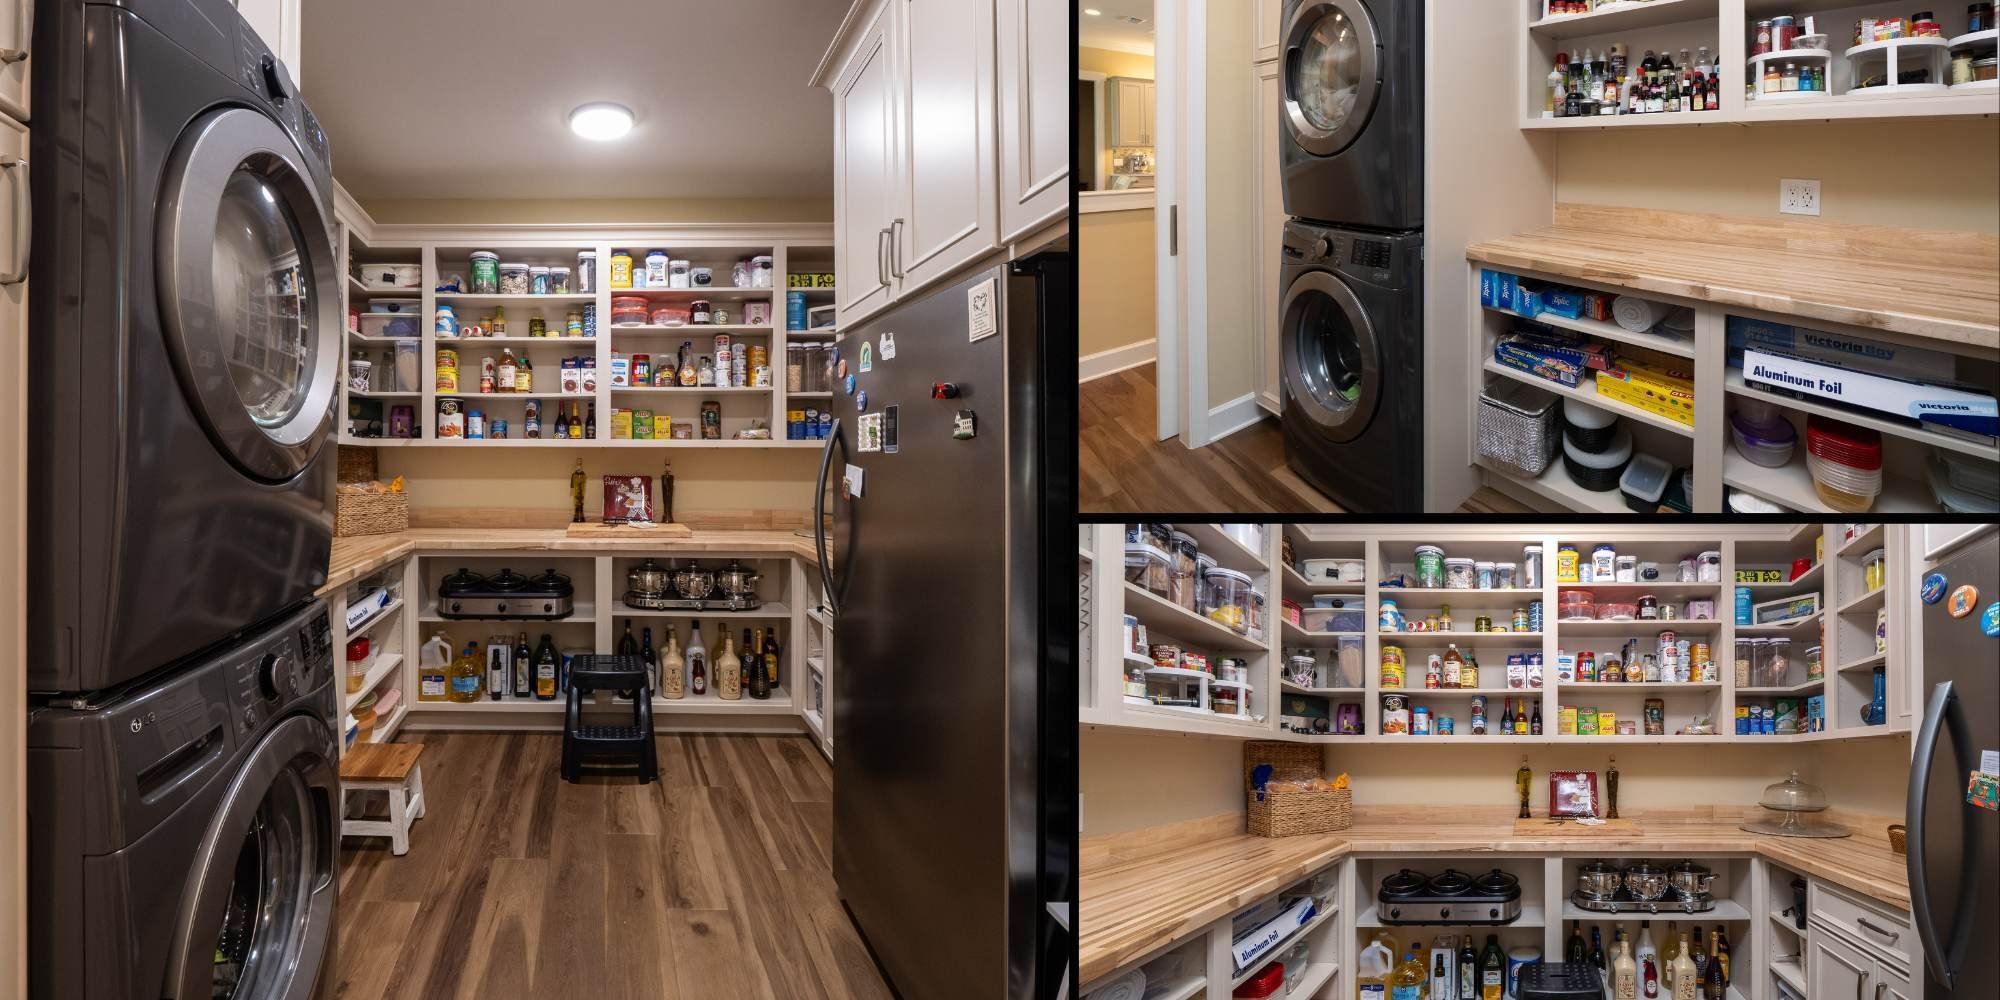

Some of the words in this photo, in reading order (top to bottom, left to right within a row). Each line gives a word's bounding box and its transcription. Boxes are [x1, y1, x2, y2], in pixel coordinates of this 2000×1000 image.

[1804, 334, 1863, 353] Victoria
[1753, 365, 1815, 389] Aluminum
[1819, 379, 1842, 395] Foil
[1918, 403, 1970, 411] Victoria
[1241, 938, 1269, 962] Aluminum
[1268, 930, 1279, 943] Foil
